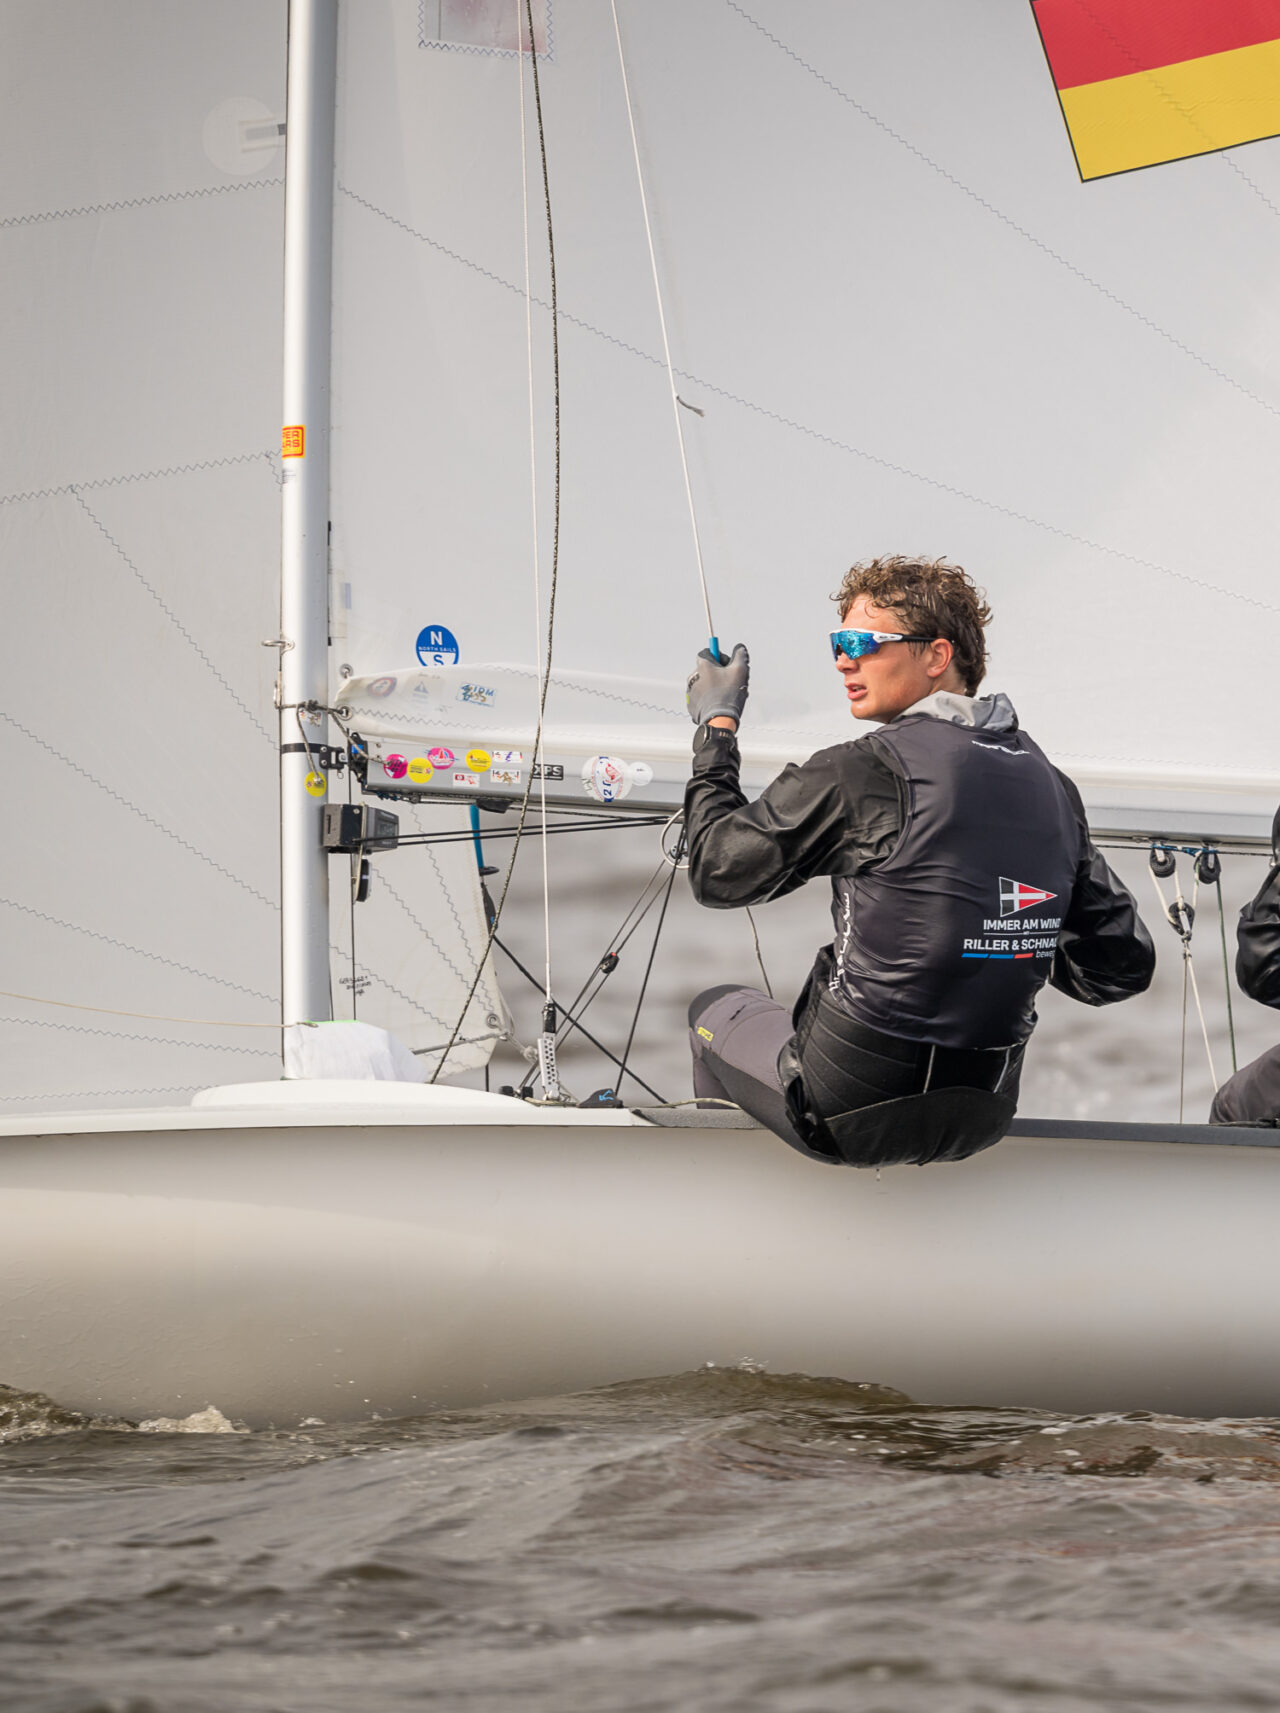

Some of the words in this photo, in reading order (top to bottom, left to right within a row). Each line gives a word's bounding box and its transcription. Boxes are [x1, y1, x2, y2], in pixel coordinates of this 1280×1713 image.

[430, 631, 443, 645] N
[433, 654, 445, 665] S
[983, 919, 1021, 931] IMMER
[1022, 919, 1039, 930] AM
[963, 939, 1009, 951] RILLER
[1011, 940, 1020, 950] &
